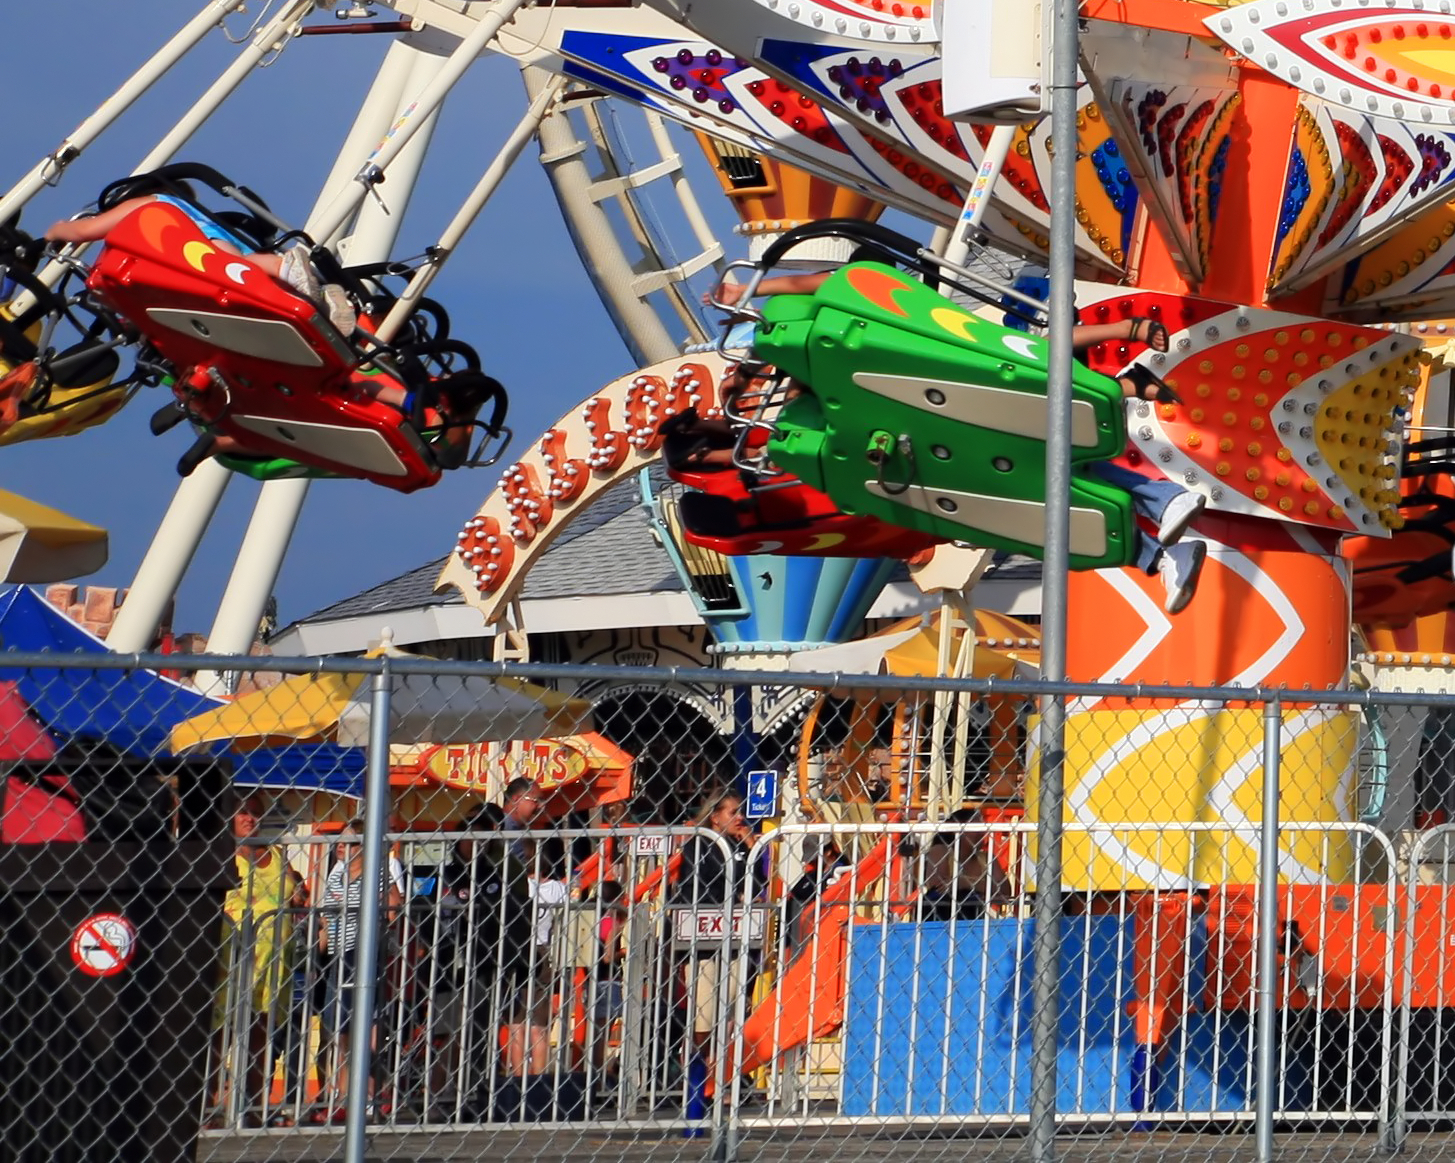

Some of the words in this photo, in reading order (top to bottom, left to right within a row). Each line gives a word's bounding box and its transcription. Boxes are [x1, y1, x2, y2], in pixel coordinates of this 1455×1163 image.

[756, 777, 767, 798] 4
[640, 837, 662, 850] EXIT
[698, 916, 743, 933] EXT
